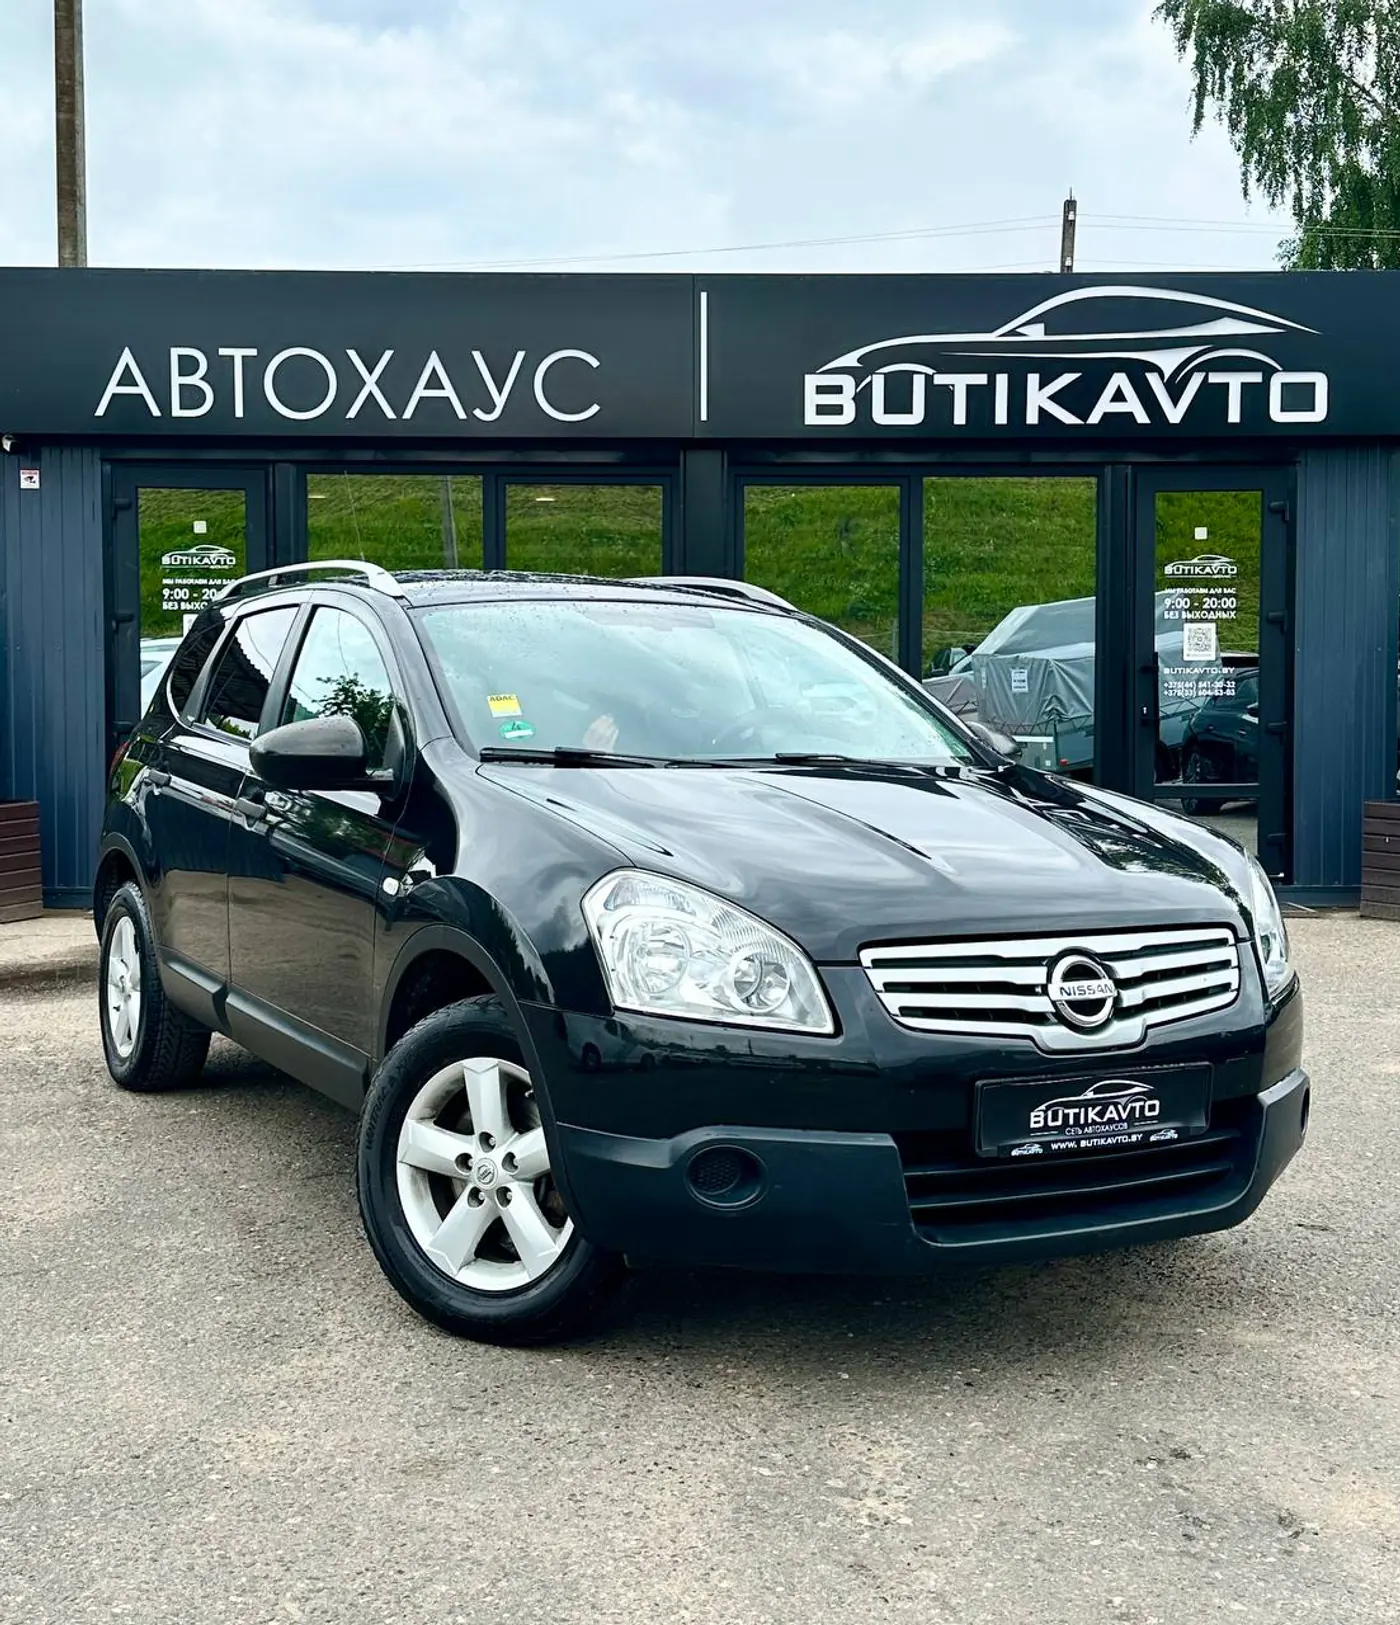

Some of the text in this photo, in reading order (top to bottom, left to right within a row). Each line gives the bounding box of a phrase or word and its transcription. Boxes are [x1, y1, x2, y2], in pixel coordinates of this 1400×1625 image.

[94, 346, 601, 422] АВТОХАУС
[804, 371, 1329, 426] BUTIKAVTO
[162, 555, 236, 565] BUTIKAVTO
[1164, 566, 1238, 575] BUTIKAVTO
[162, 588, 190, 600] 9:00
[162, 601, 179, 610] БЕЗ
[1164, 597, 1191, 609] 9:00
[1202, 597, 1237, 609] 20:00
[1164, 610, 1237, 619] БЕЗ ВЫХОДНЫХ
[1060, 983, 1113, 997] NISSAN
[1029, 1100, 1160, 1128] BUTIKAVTO
[1065, 1127, 1082, 1135] СЕТЬ
